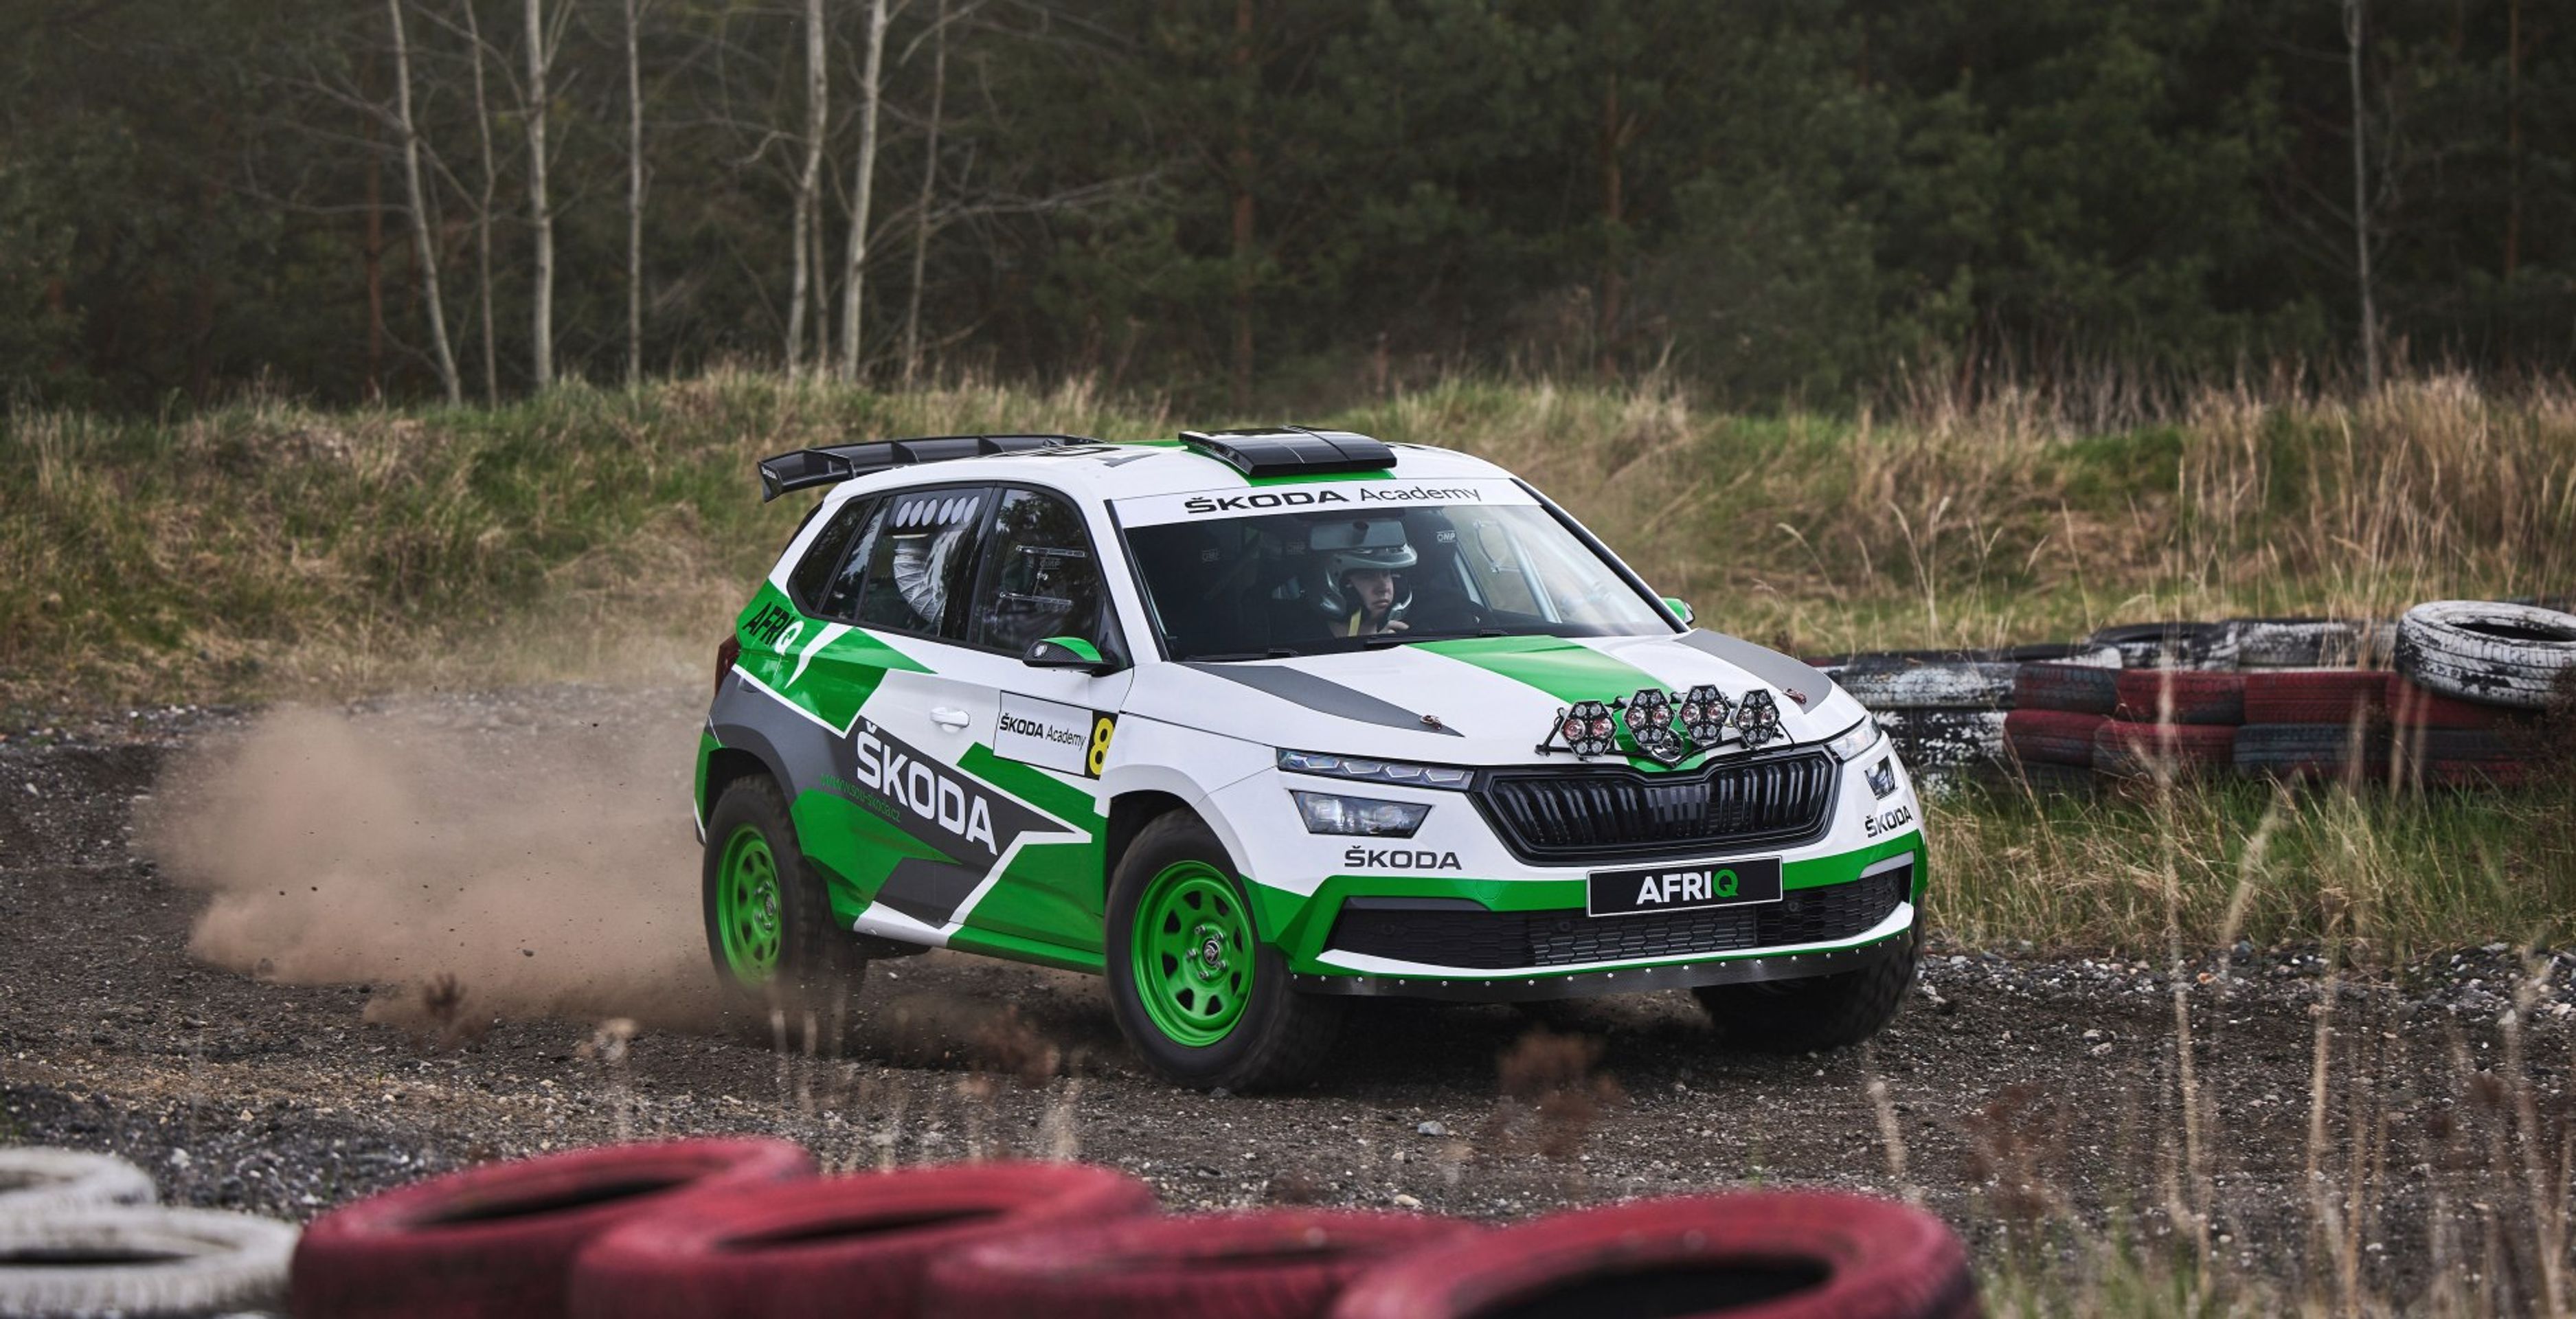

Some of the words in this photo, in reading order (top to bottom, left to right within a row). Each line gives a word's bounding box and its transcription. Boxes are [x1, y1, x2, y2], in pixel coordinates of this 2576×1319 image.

[1184, 490, 1350, 514] ŠKODA
[1359, 486, 1482, 502] Academy
[742, 601, 804, 656] AFRIQ
[999, 712, 1043, 739] ŠKODA
[1046, 725, 1086, 751] Academy
[1089, 717, 1116, 775] 8
[857, 721, 998, 856] ŠKODA
[1864, 805, 1913, 838] ŠKODA
[1344, 845, 1462, 870] ŠKODA
[1636, 869, 1739, 905] AFRIQ
